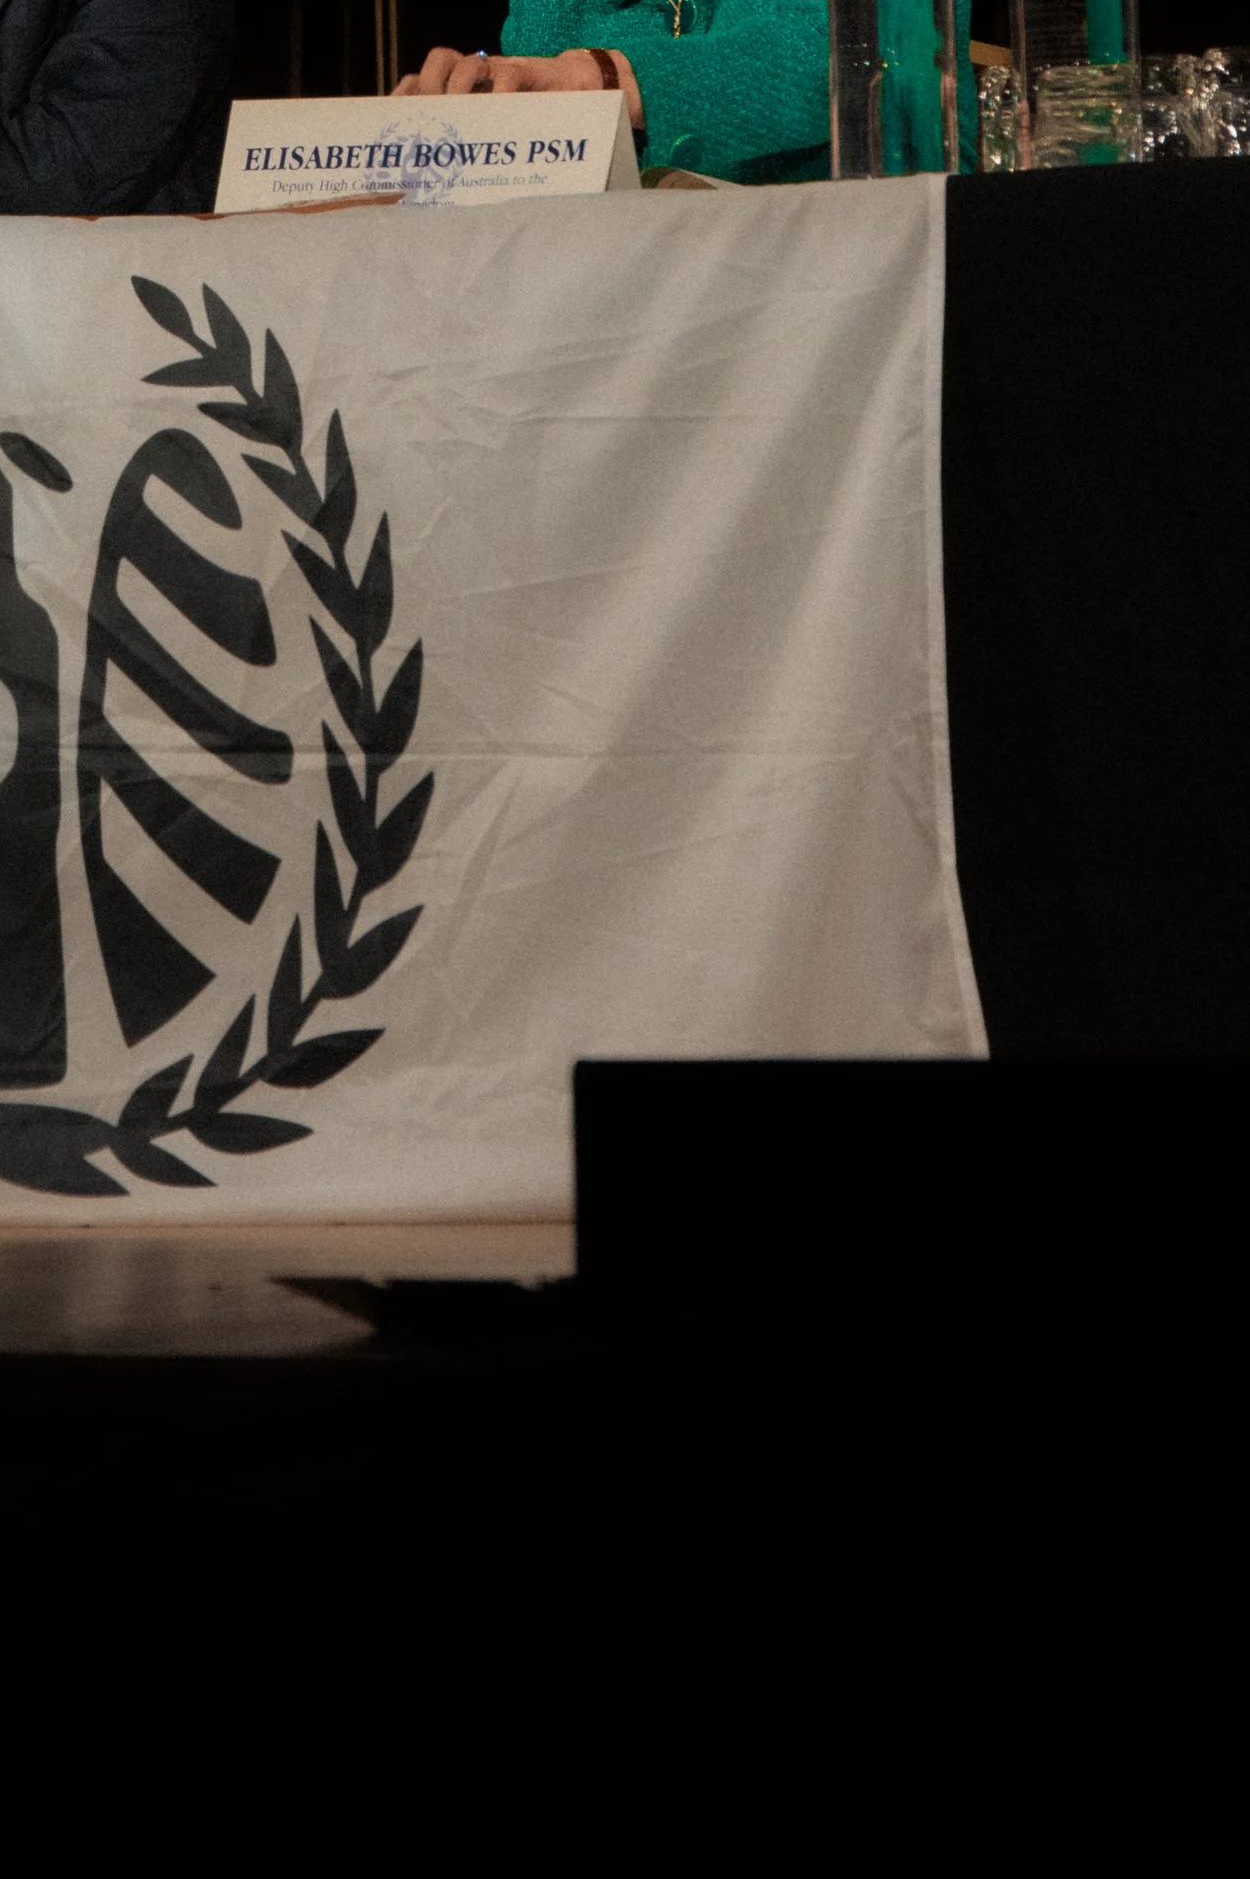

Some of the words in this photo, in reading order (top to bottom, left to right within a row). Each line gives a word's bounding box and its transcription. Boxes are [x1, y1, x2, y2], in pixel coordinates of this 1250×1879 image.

[244, 144, 404, 171] ELISABETH
[413, 141, 517, 168] BOWES
[526, 138, 589, 164] PSM
[272, 180, 314, 195] Deputy
[319, 179, 349, 194] High
[352, 177, 440, 191] Commissioner
[459, 175, 509, 187] Australia
[513, 175, 526, 185] to
[528, 173, 547, 185] the
